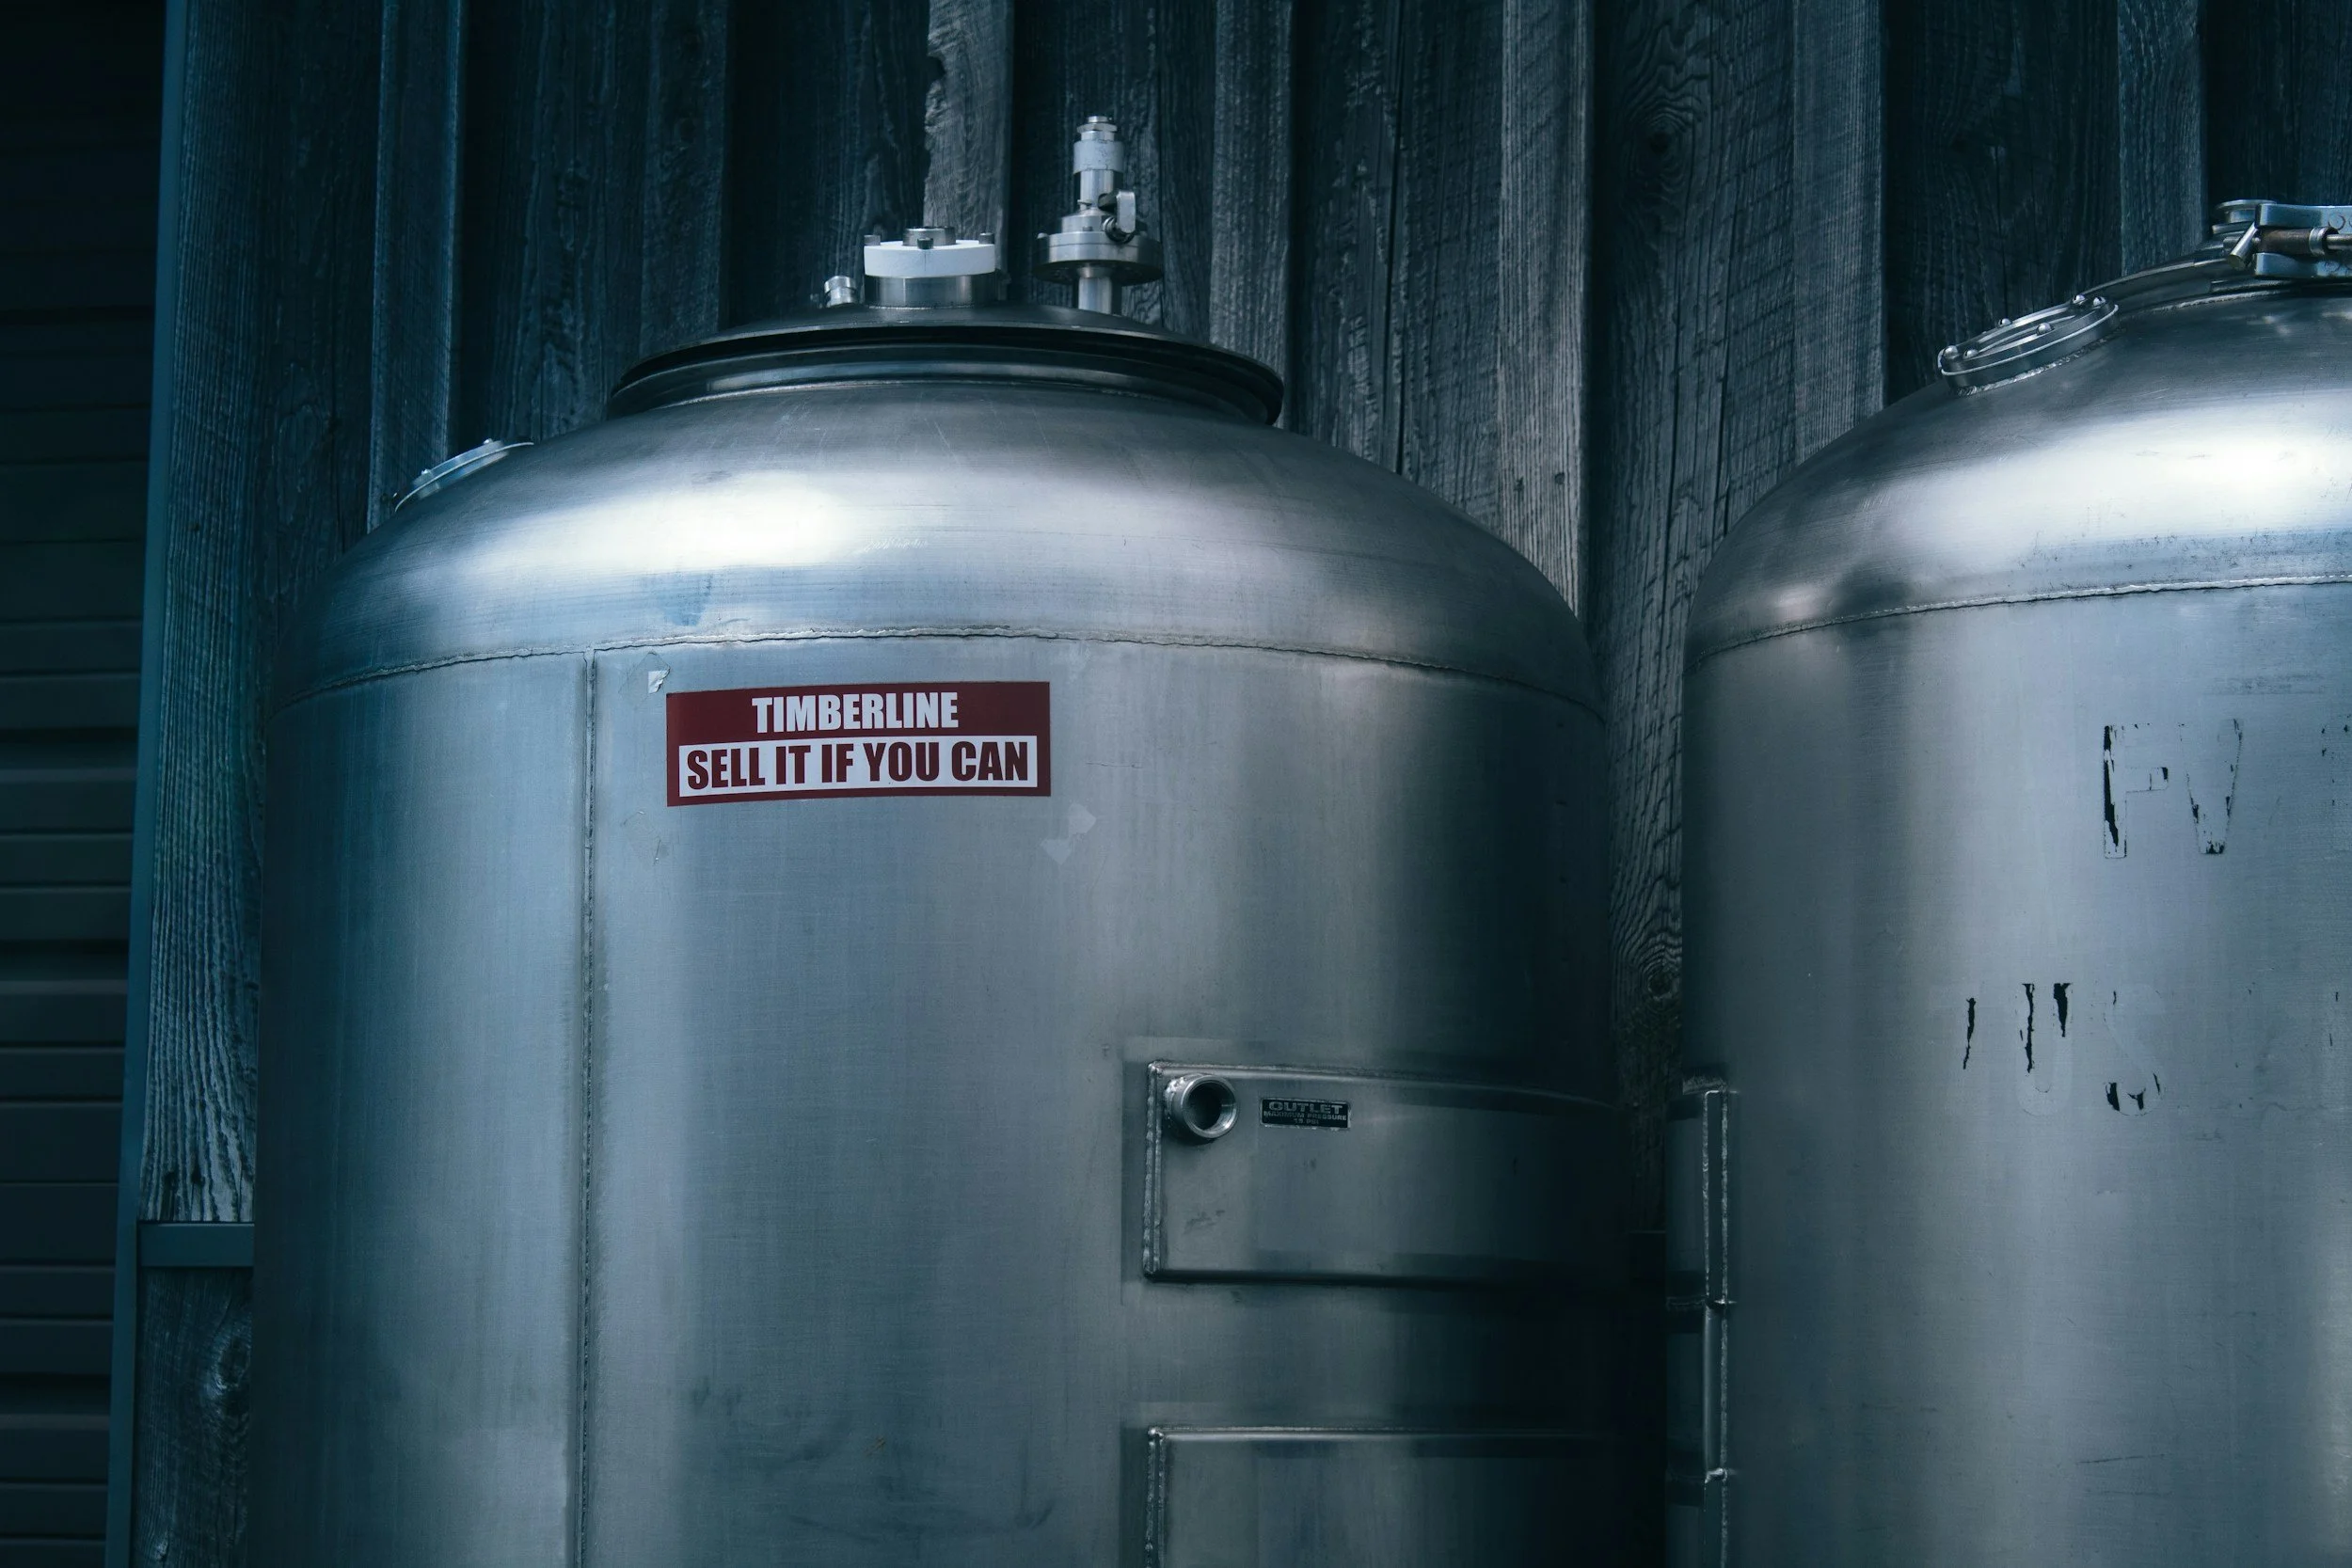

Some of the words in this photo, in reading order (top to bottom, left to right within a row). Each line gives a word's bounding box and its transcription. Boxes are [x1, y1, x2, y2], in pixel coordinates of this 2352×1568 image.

[752, 691, 960, 734] TIMBERLINE
[687, 747, 766, 790] SELL
[775, 744, 811, 784] IT
[821, 742, 854, 784] IF
[863, 741, 941, 782] YOU
[951, 740, 1028, 782] CAN
[1269, 1101, 1343, 1115] OUTLET
